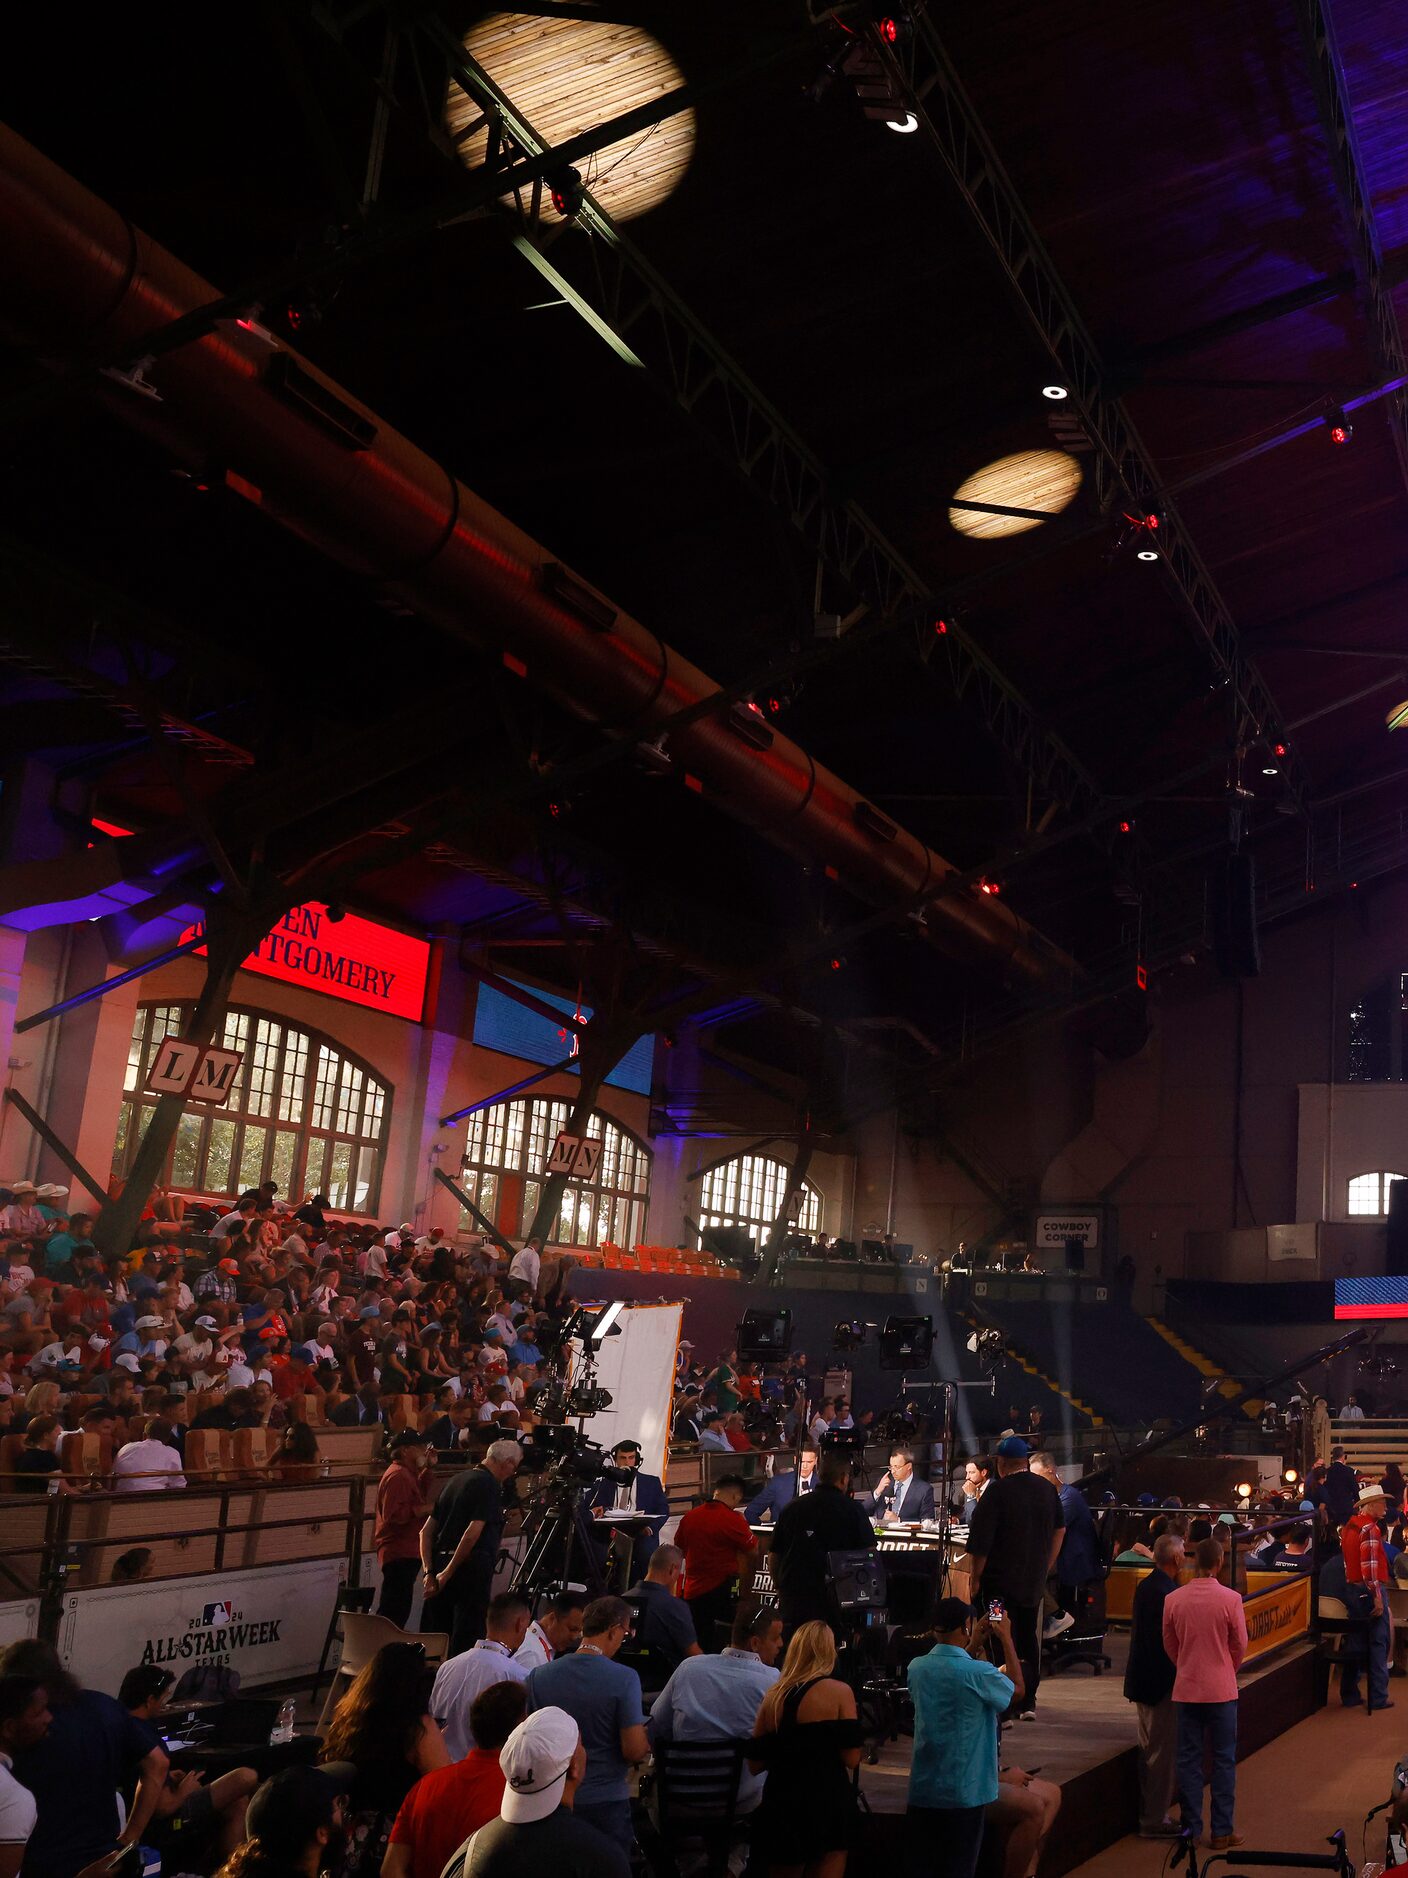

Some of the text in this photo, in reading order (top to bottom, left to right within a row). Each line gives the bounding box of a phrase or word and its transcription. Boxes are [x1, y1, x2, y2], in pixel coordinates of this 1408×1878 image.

[160, 1051, 235, 1089] L M
[553, 1141, 598, 1169] M N
[1043, 1222, 1092, 1231] COWBOY
[1045, 1233, 1089, 1242] CORNER
[189, 1611, 243, 1629] 20 24
[228, 1619, 282, 1650] WEEK
[195, 1653, 230, 1668] TEXAS
